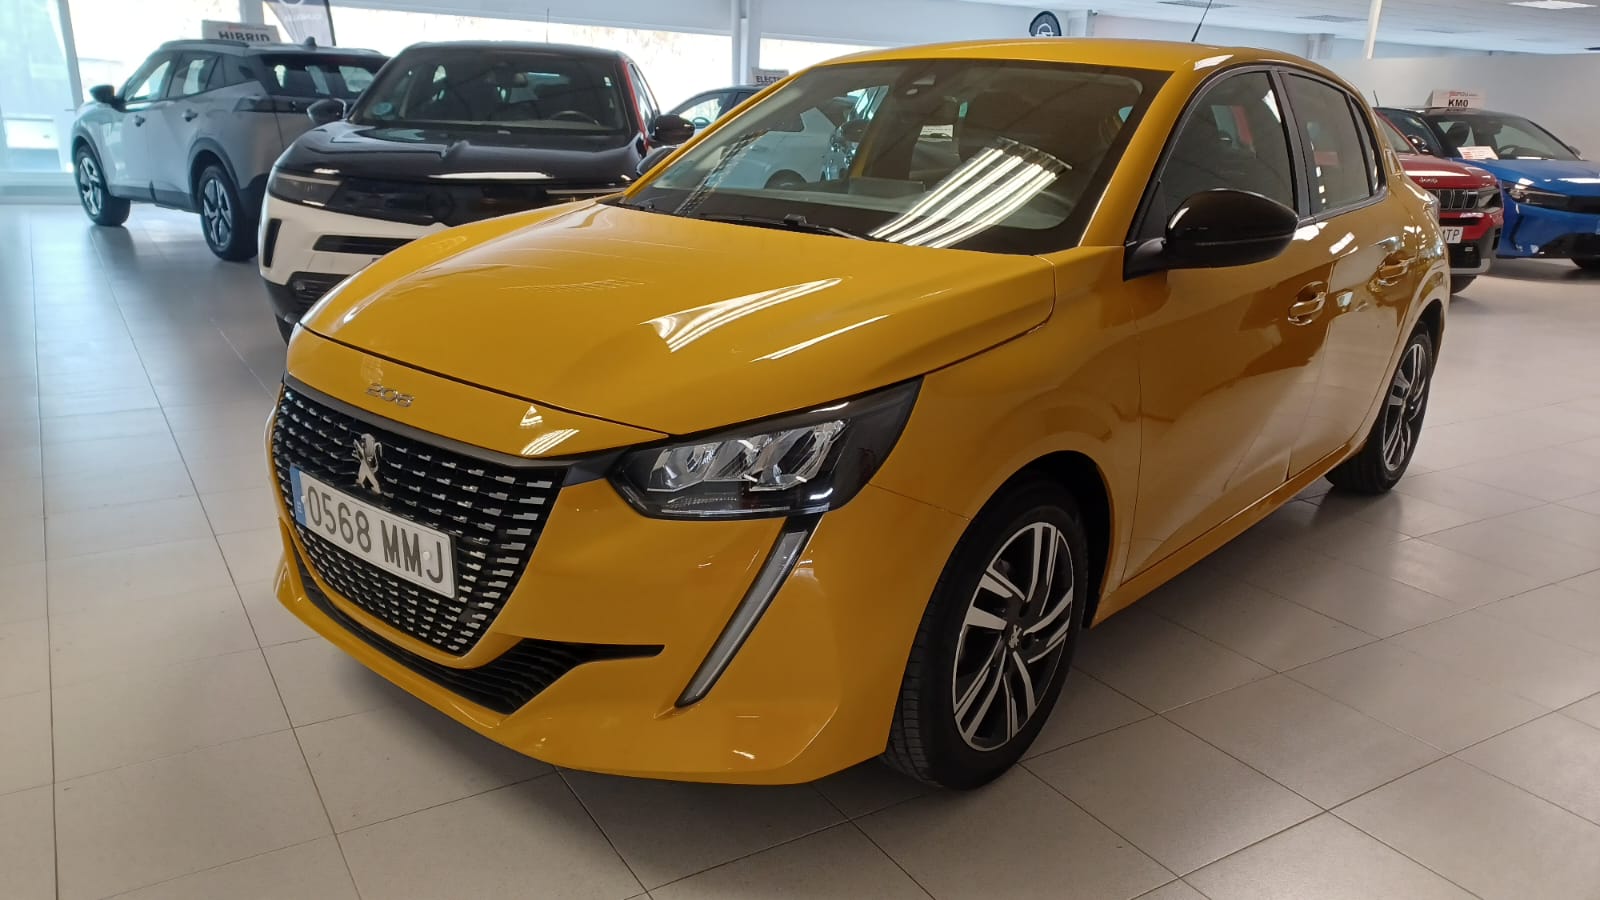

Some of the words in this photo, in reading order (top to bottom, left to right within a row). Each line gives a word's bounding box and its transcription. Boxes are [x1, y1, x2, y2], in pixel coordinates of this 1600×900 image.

[1448, 98, 1469, 108] KM0
[1443, 229, 1460, 241] TP
[307, 485, 372, 554] 0568
[380, 519, 444, 584] MMJ
